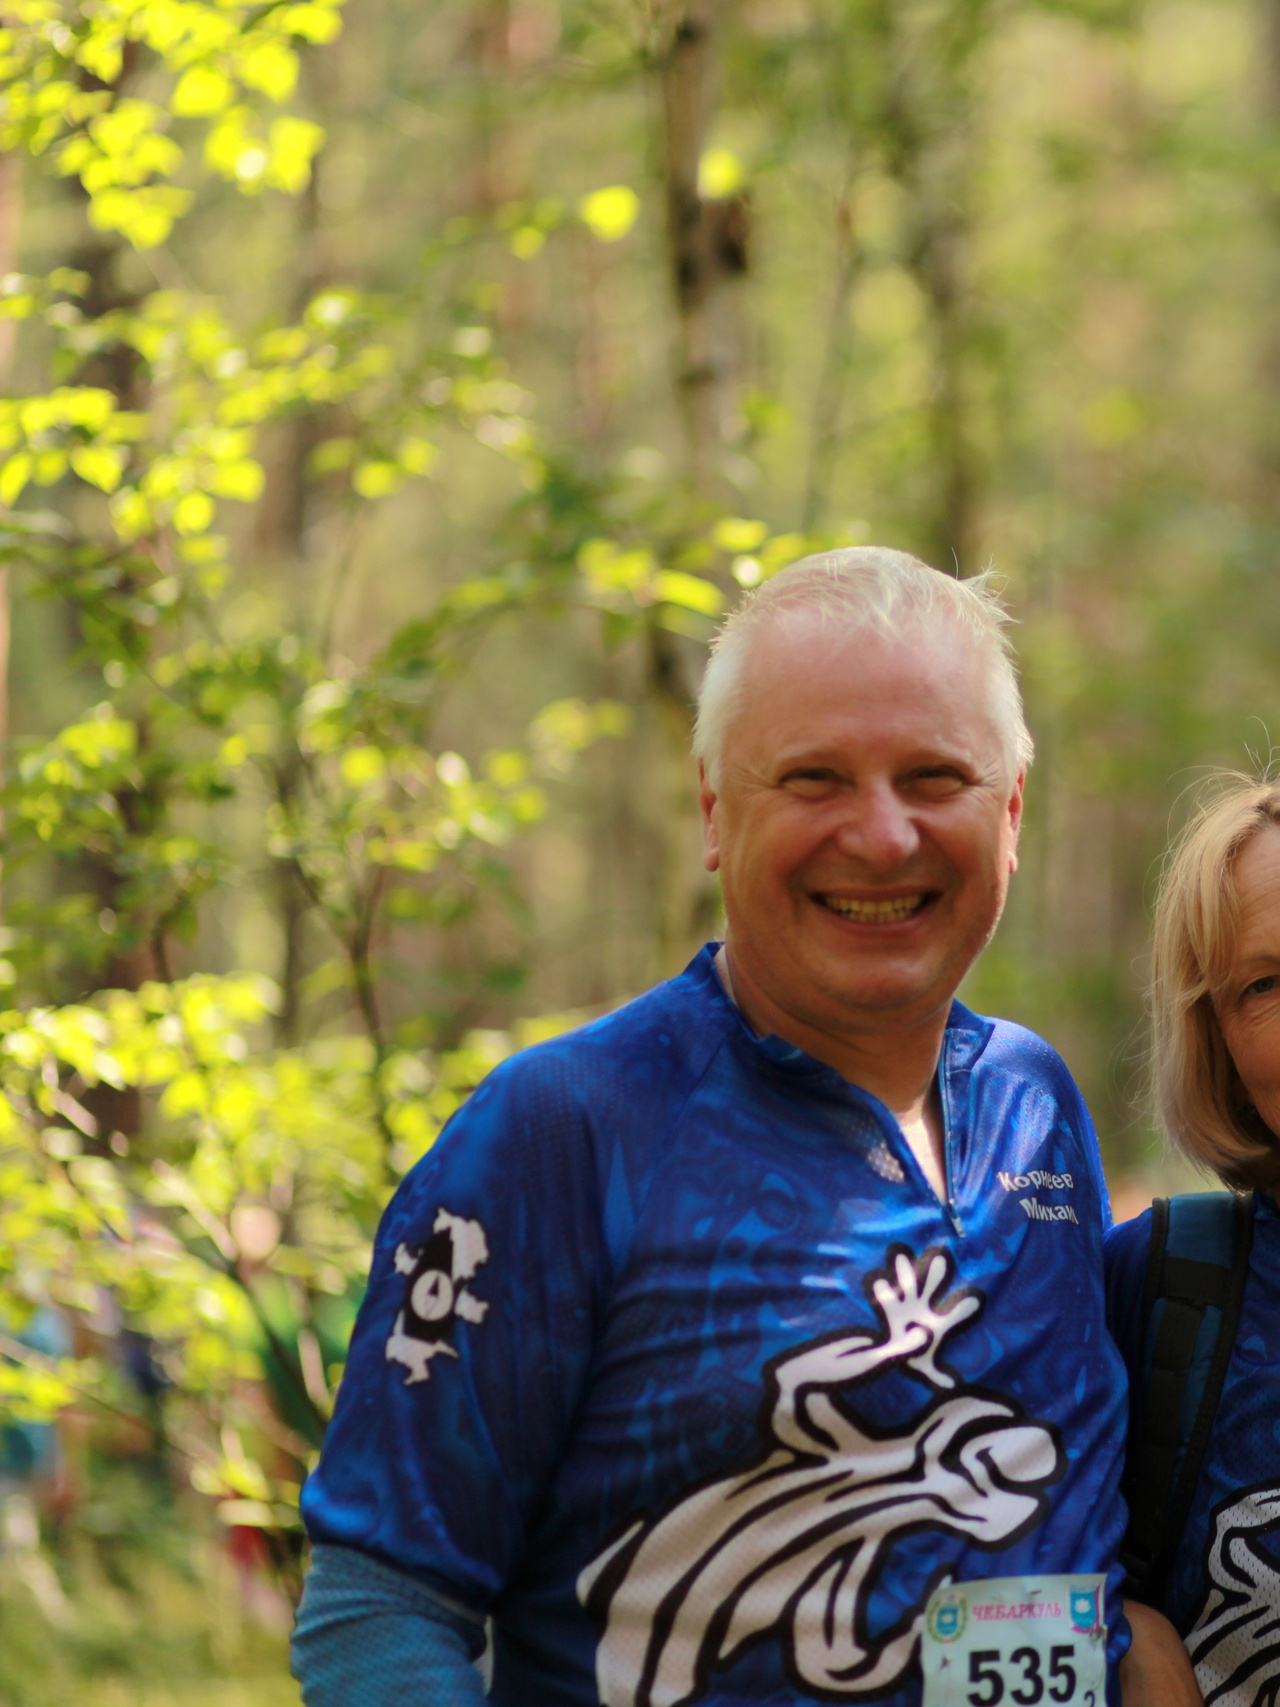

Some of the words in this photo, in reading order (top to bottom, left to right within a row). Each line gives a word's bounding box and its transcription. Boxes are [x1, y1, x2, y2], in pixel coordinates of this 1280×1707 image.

[997, 1169, 1074, 1192] Корнеев
[972, 1602, 1062, 1622] ЧЕБАРКУЛЬ
[967, 1645, 1076, 1707] 535
